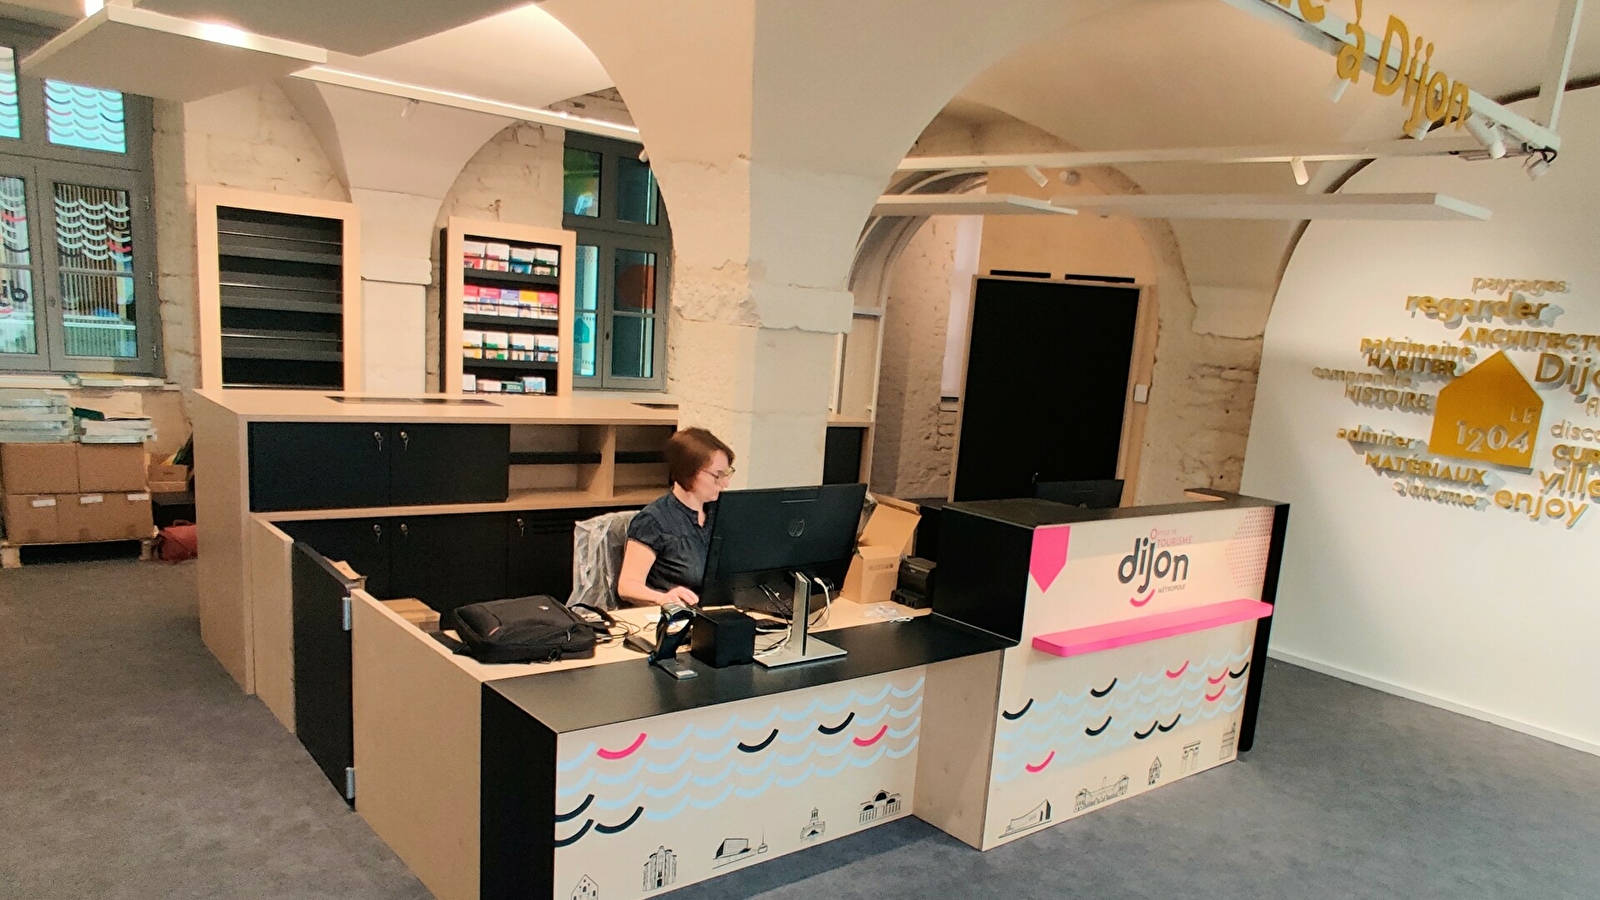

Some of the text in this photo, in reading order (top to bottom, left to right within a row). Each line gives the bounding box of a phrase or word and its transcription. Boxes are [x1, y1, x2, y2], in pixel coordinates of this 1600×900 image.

[1336, 0, 1469, 135] à Dijon
[1405, 292, 1550, 322] regarder
[1360, 336, 1473, 358] patrimoine
[1459, 326, 1600, 352] ARCHITECT
[1367, 352, 1457, 377] HABITER
[1344, 383, 1430, 409] HISTOIRE
[1509, 406, 1537, 424] LE
[1336, 424, 1415, 449] admirer
[1456, 420, 1530, 455] 1204
[1365, 453, 1487, 486] MATÉRIAUX
[1494, 487, 1589, 529] enjoy
[1157, 535, 1193, 547] TOURISME
[1118, 537, 1189, 594] dijon
[1158, 583, 1186, 594] MÉTROPOLE
